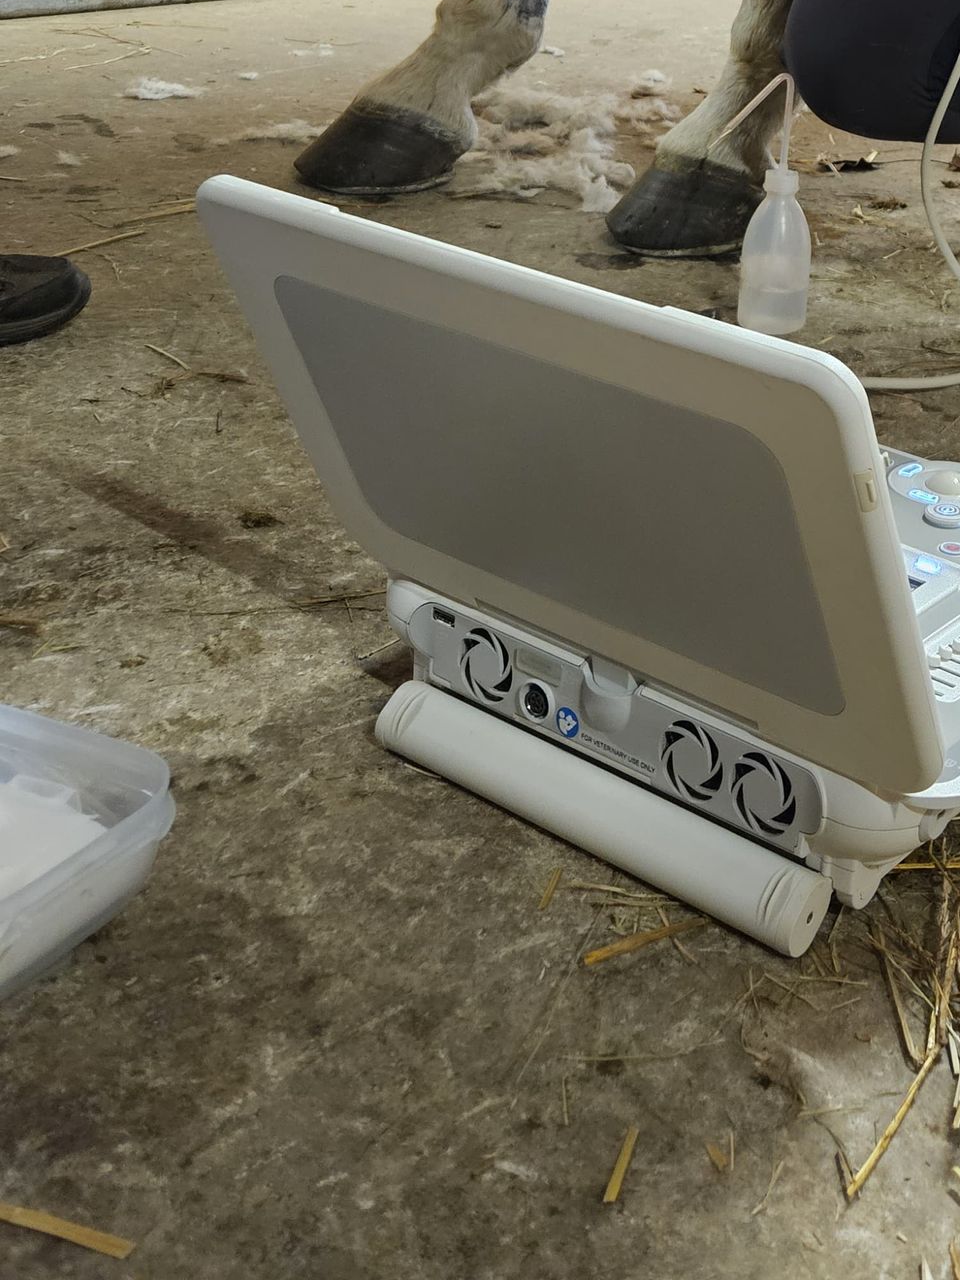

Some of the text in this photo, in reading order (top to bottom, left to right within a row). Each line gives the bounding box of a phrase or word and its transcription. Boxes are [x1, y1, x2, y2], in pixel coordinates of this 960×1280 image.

[581, 732, 656, 773] FOR VETERINARY USE ONLY
